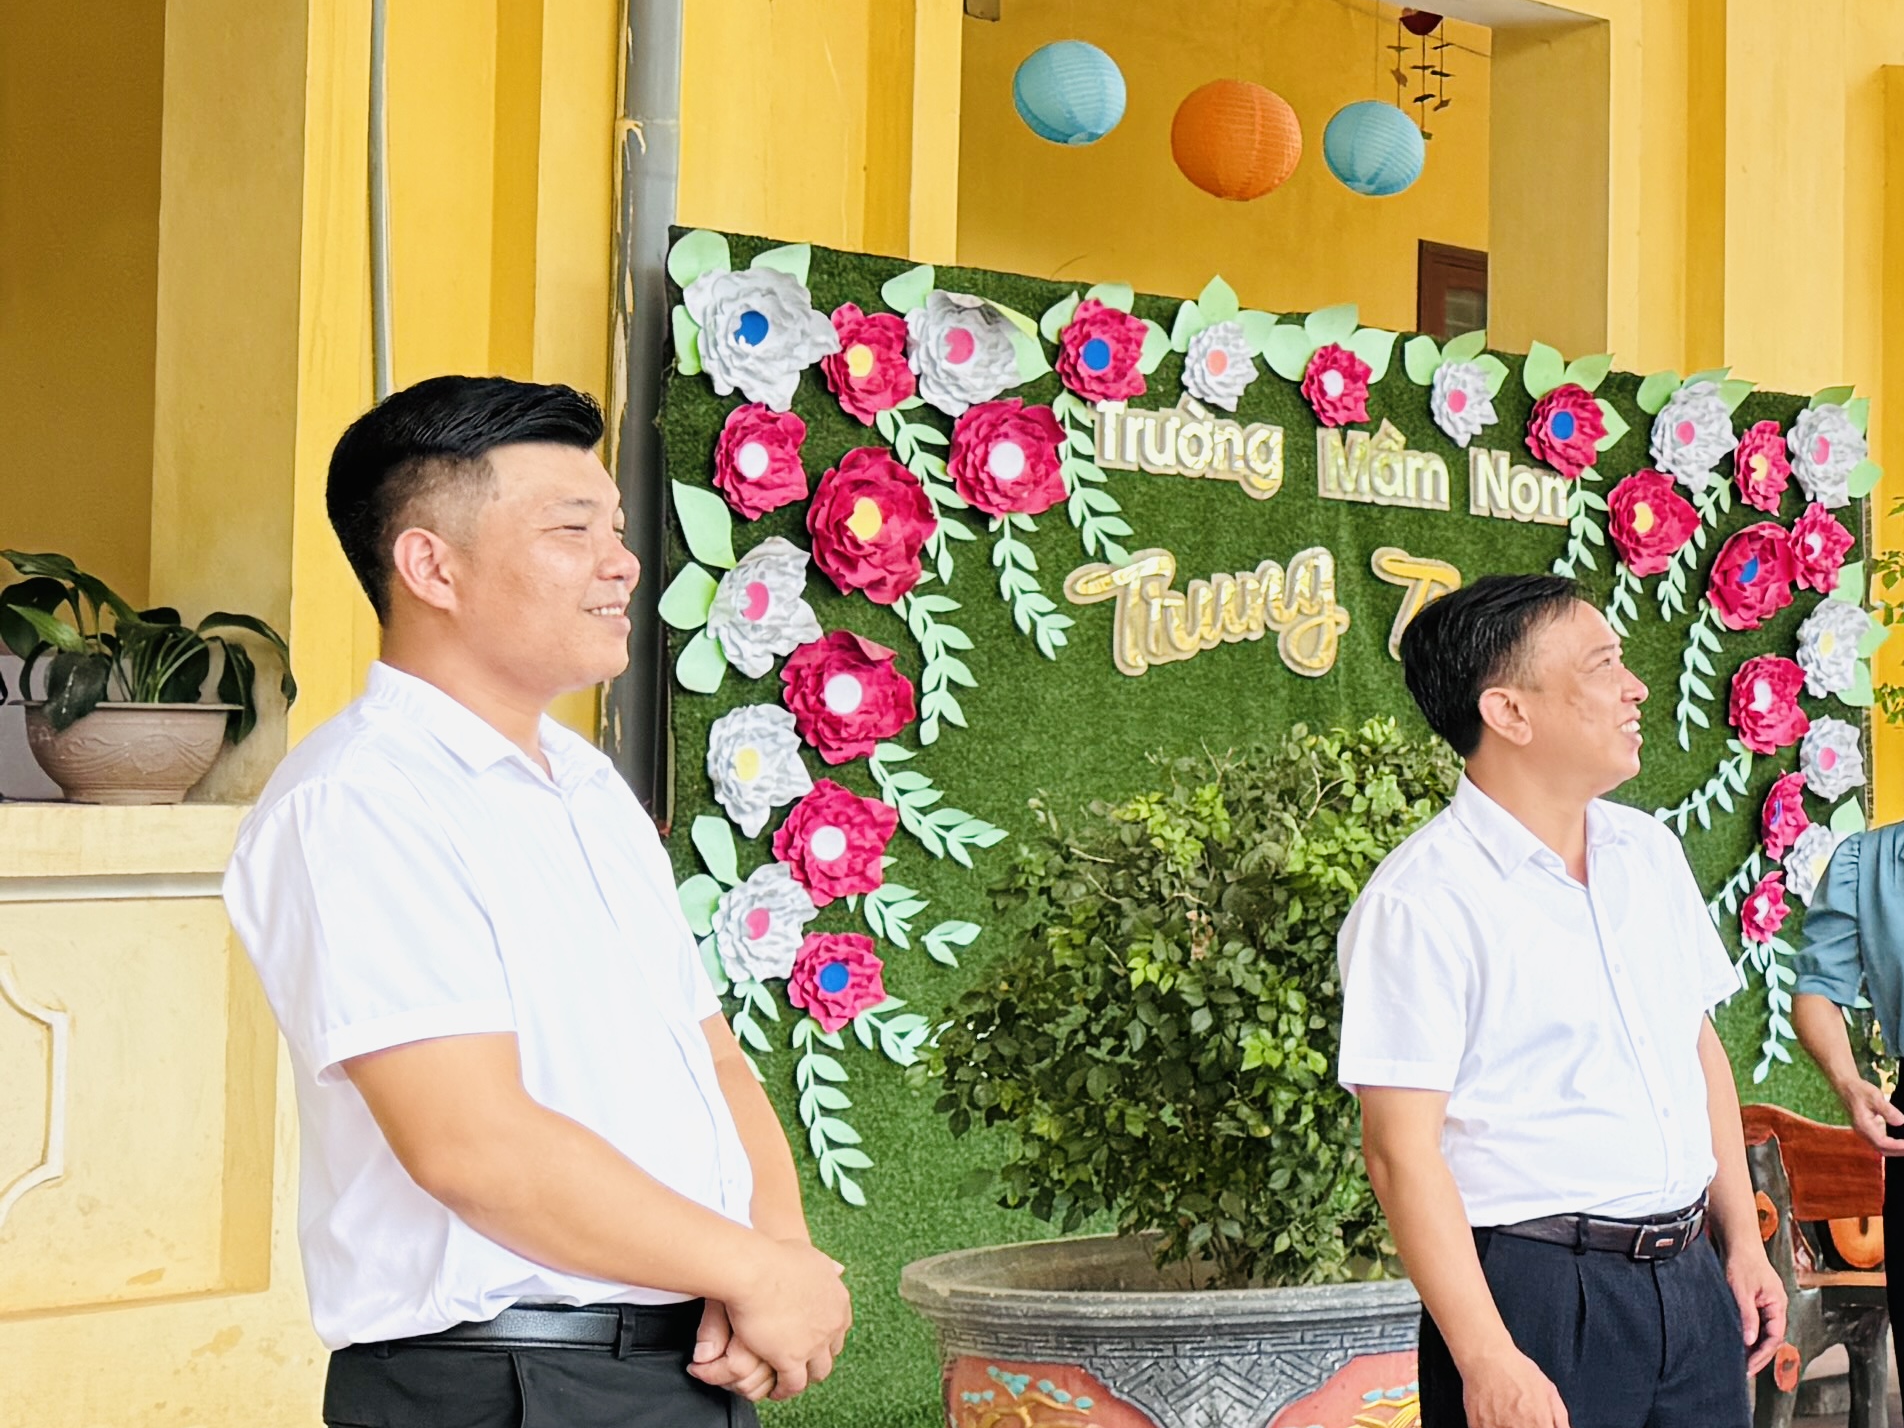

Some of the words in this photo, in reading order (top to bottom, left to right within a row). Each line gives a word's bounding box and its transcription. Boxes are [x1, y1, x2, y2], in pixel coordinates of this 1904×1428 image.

[1095, 399, 1284, 491] Trường
[1326, 420, 1448, 504] Mầm
[1472, 449, 1569, 519] Non
[1074, 553, 1347, 670] Trung
